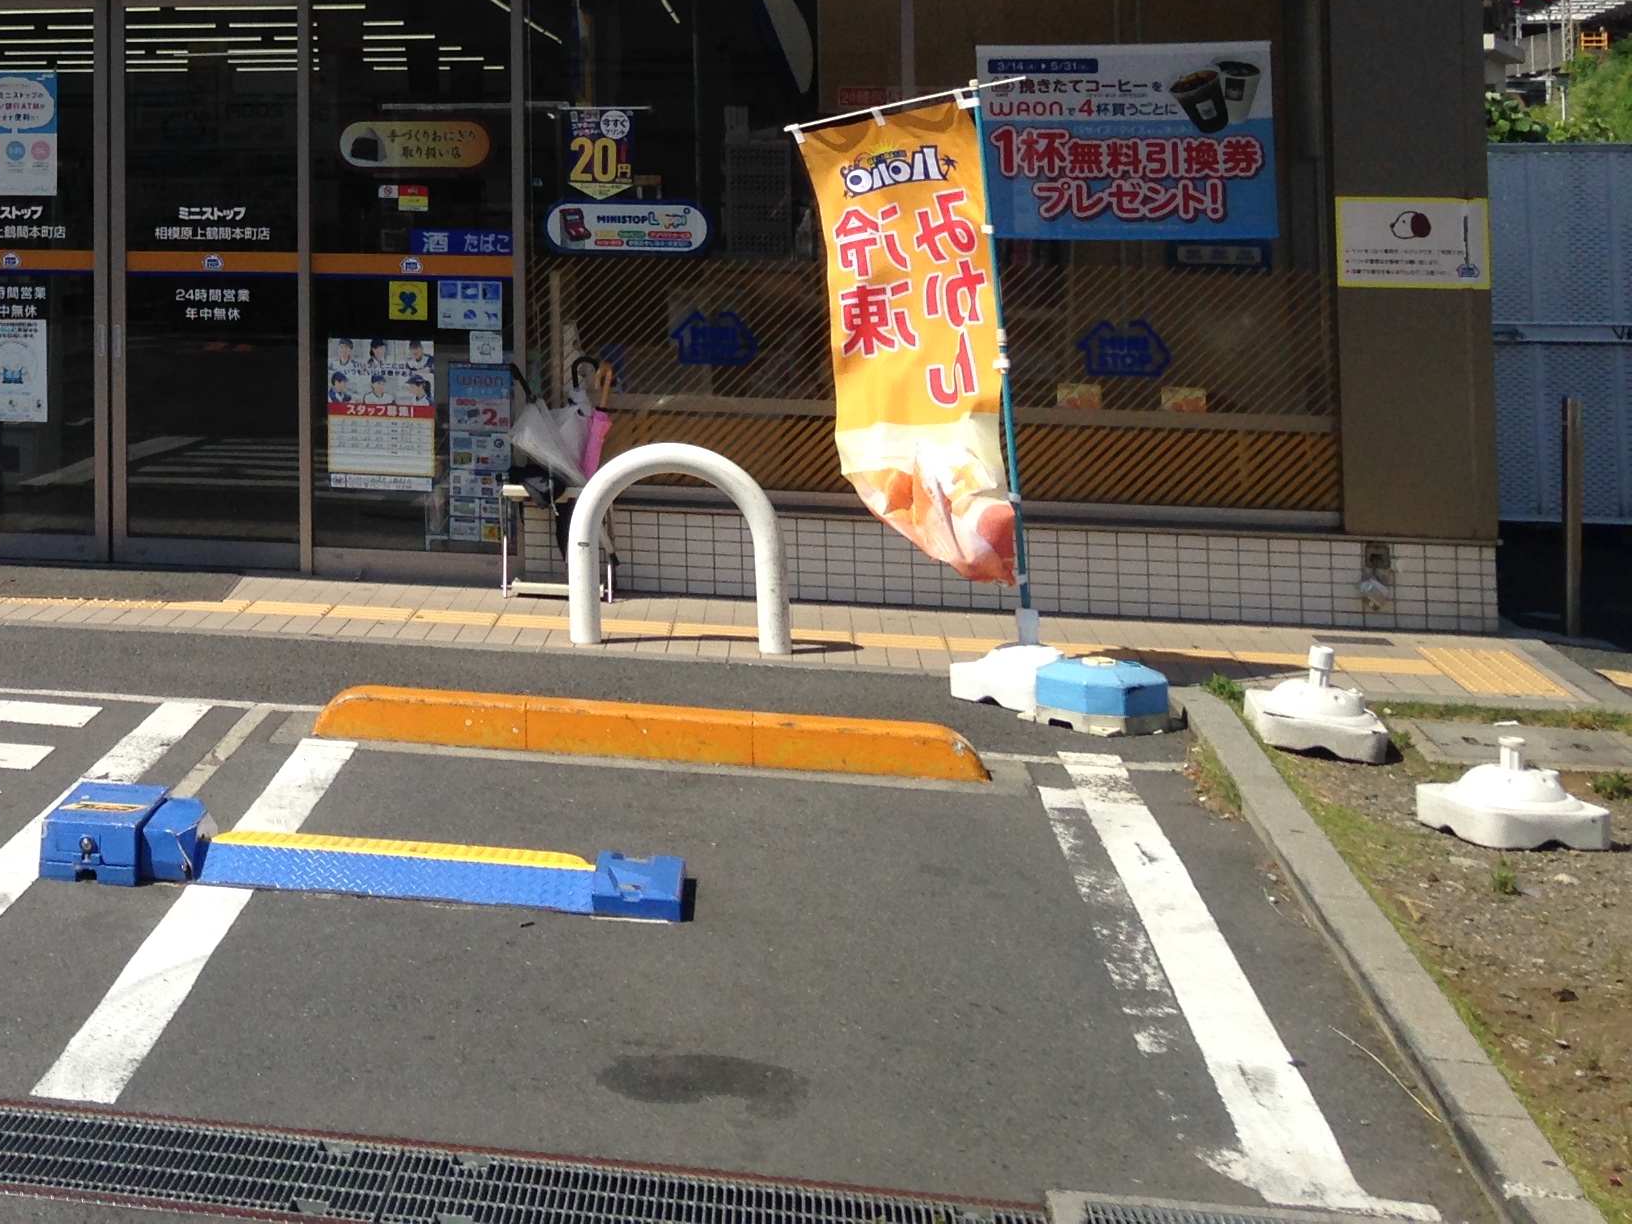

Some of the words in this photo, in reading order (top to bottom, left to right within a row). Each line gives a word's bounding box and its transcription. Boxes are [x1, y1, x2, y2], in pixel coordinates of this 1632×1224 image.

[1019, 78, 1163, 95] 挽きたてコーヒーを
[387, 128, 476, 143] 手づくりおにぎり
[401, 146, 462, 159] 取り扱い店
[991, 125, 1264, 178] 1杯無料引換券
[178, 207, 247, 221] ミニストップ
[154, 226, 271, 242] 相模原上鶴間本町店
[422, 231, 450, 253] 酒
[463, 233, 511, 253] たばこ
[175, 288, 251, 303] 24時間営業
[185, 307, 241, 321] 年中無休
